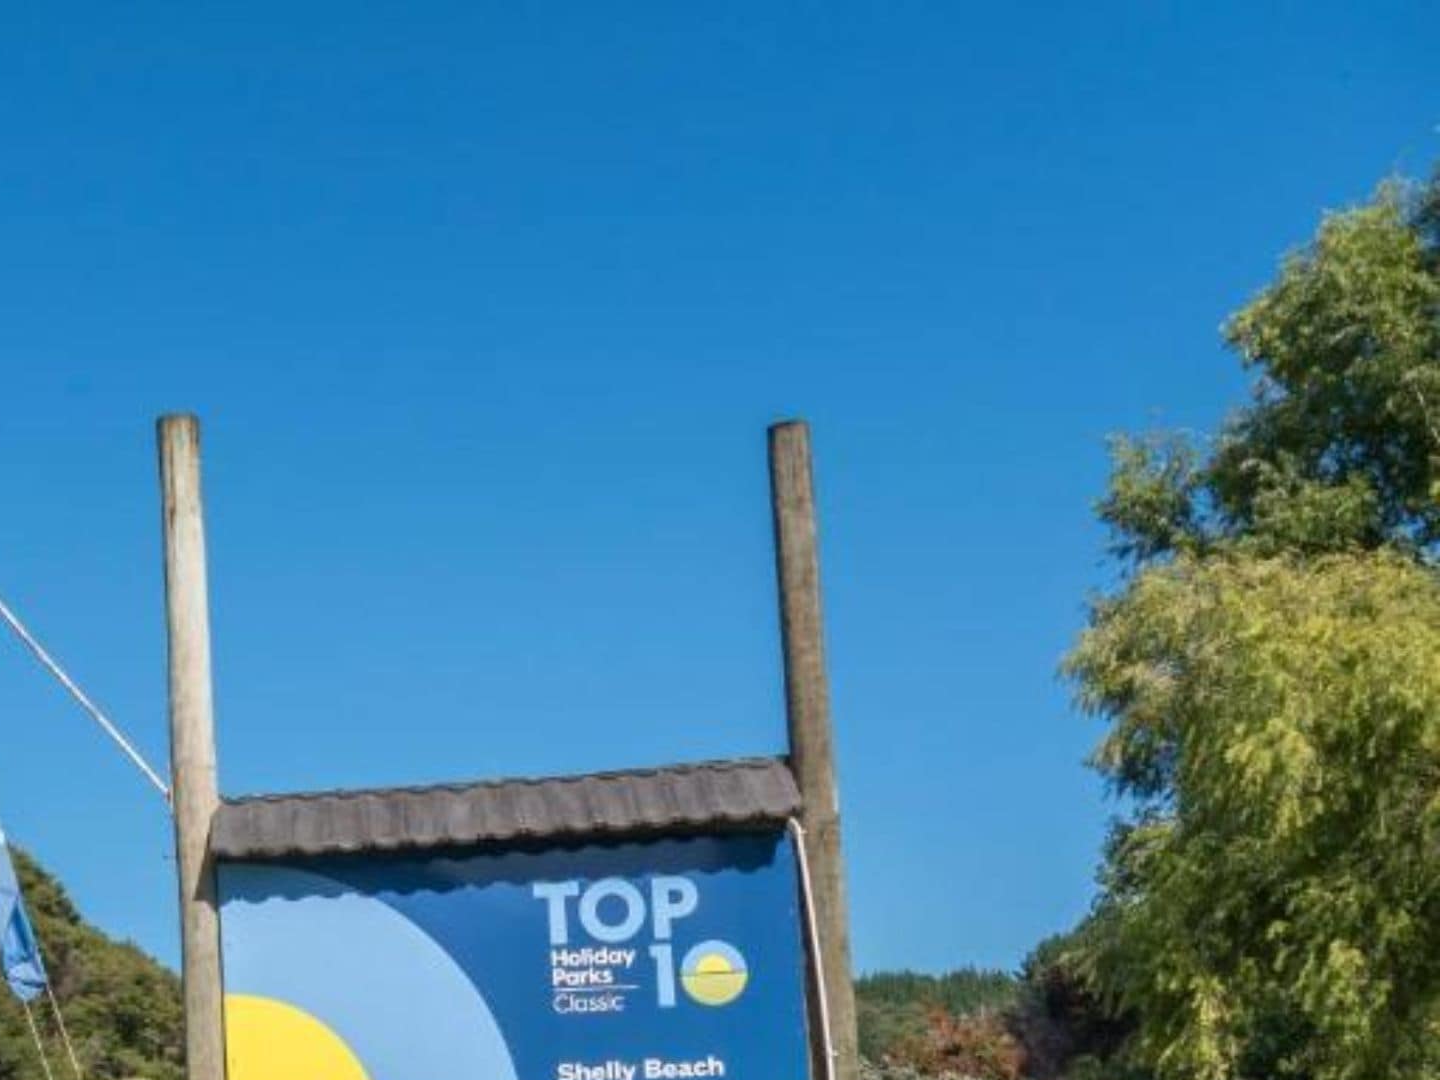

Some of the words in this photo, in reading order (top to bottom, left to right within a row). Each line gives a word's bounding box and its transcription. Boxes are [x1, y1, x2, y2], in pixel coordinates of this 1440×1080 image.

[533, 875, 698, 944] TOP
[550, 947, 636, 969] Holiday
[552, 967, 613, 986] Parks
[649, 939, 749, 1007] 10
[552, 993, 625, 1014] Classic
[644, 1055, 725, 1079] Beach
